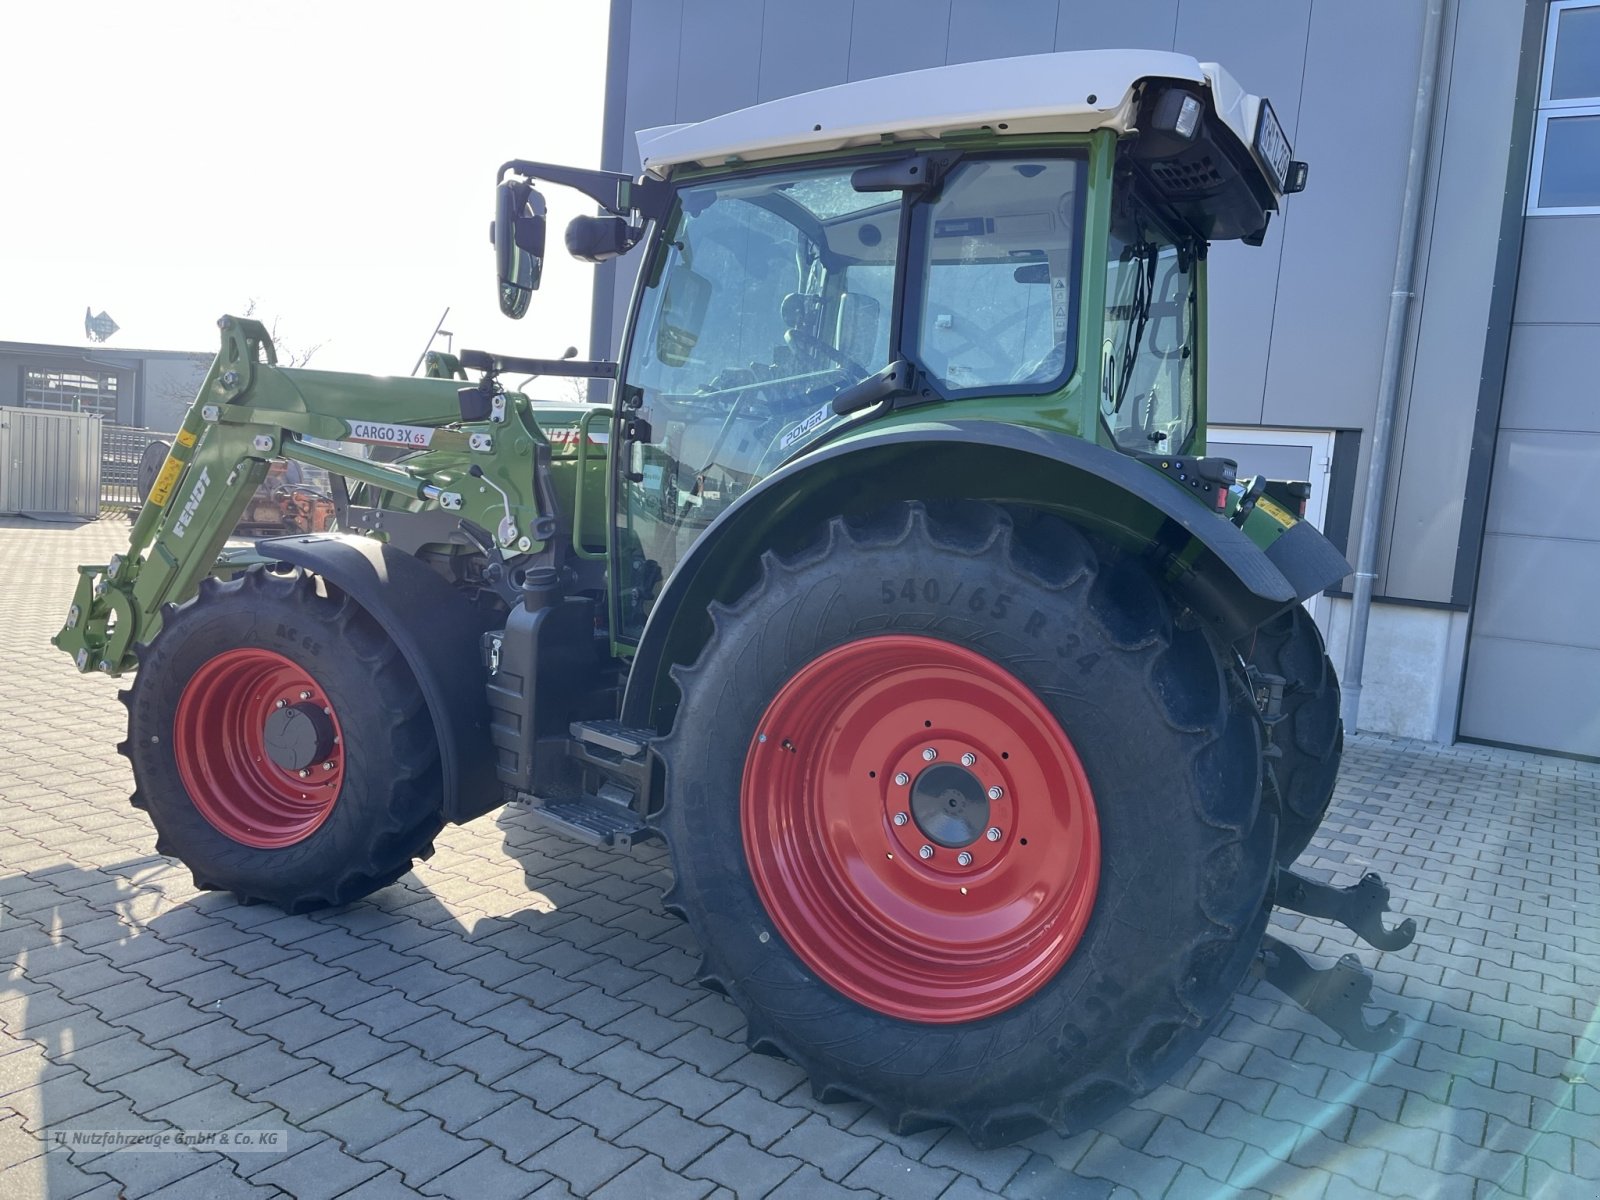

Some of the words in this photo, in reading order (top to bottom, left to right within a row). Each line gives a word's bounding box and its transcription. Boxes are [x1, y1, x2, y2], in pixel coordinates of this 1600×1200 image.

[355, 424, 395, 441] CARGO
[397, 429, 412, 443] 3X
[413, 433, 425, 444] 65
[786, 410, 823, 444] POWER
[172, 465, 211, 538] FENDT
[275, 623, 297, 642] AC
[881, 578, 1012, 620] 540/65
[1023, 609, 1047, 639] R
[1056, 633, 1101, 676] 34
